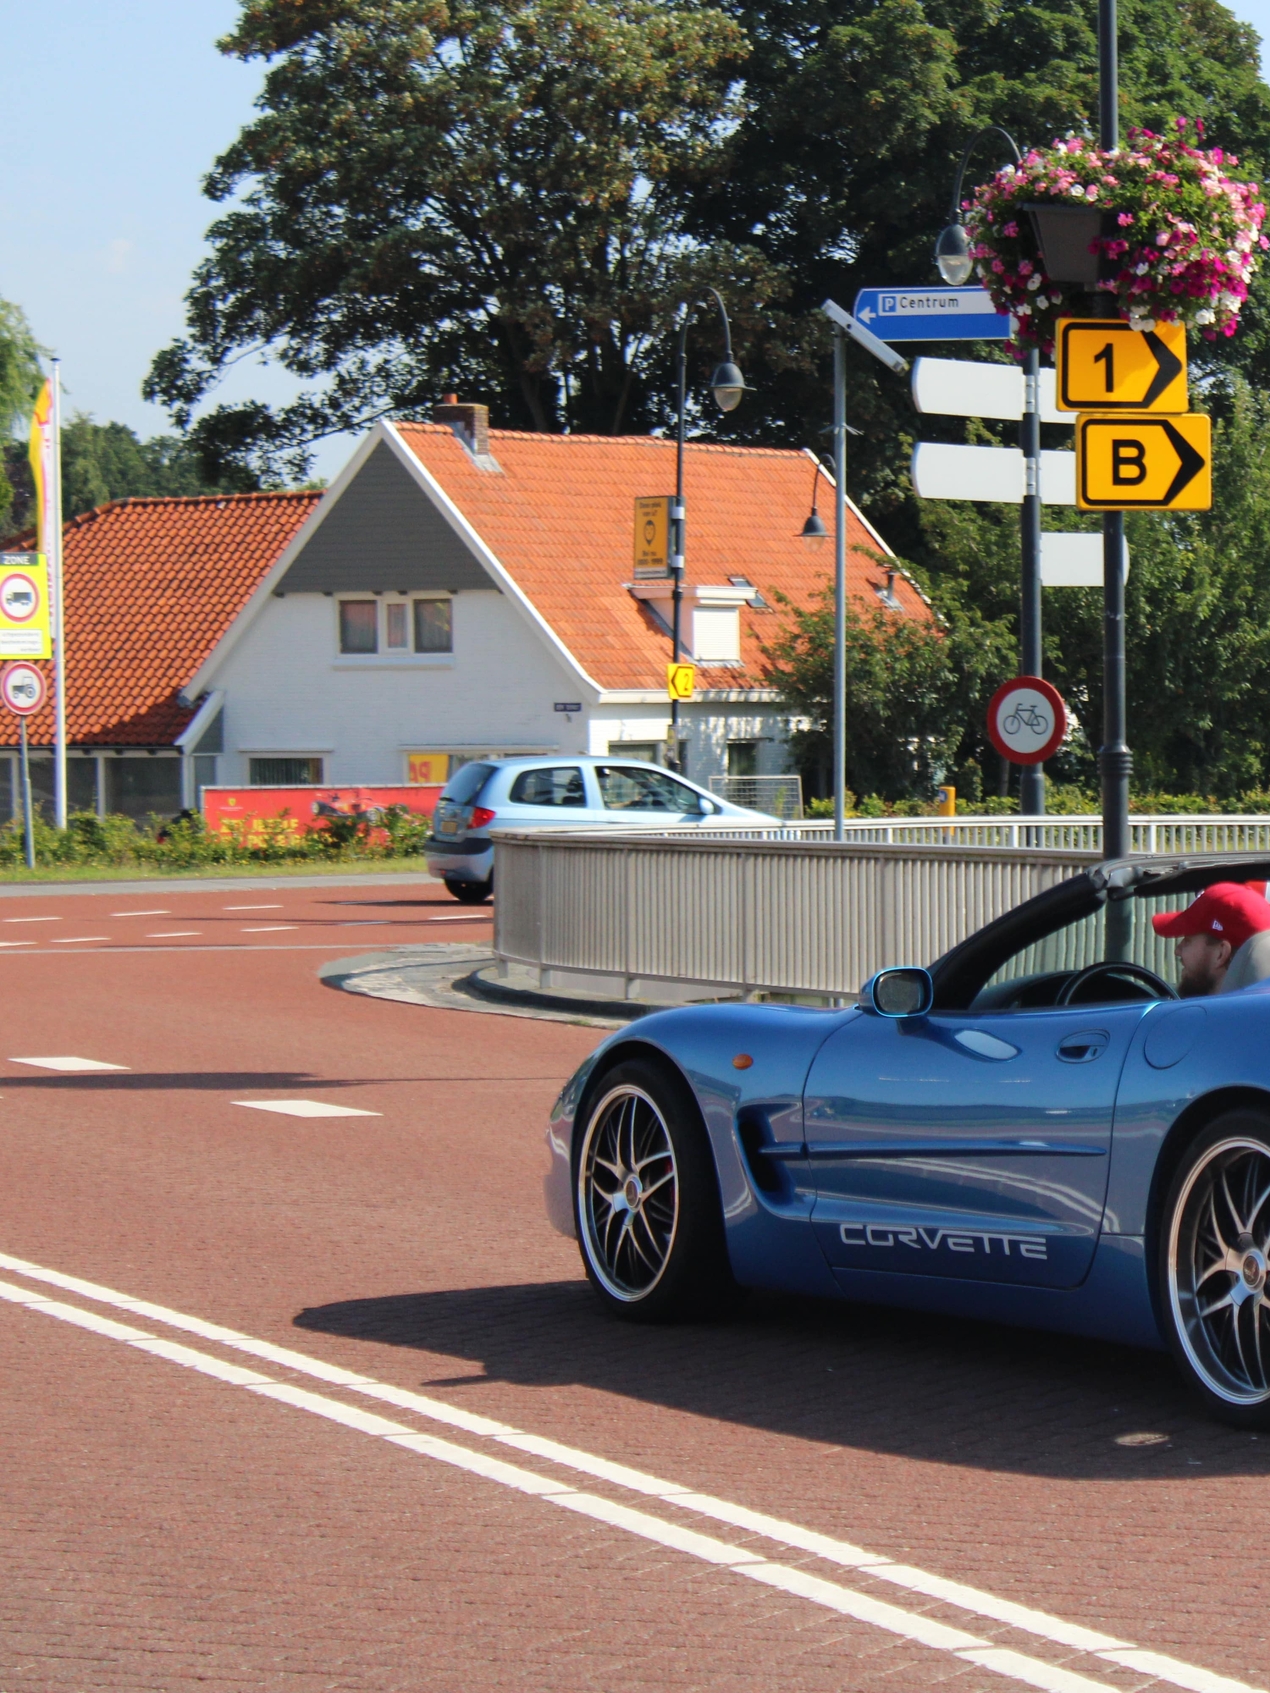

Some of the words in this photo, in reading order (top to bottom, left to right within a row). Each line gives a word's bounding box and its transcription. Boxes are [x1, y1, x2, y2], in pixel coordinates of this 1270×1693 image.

[885, 297, 895, 311] P
[900, 296, 959, 309] Centrum
[1094, 343, 1114, 393] 1
[1112, 439, 1147, 486] B
[3, 556, 30, 564] ZONE
[683, 673, 690, 692] 2
[839, 1224, 1048, 1260] CORVETTE
